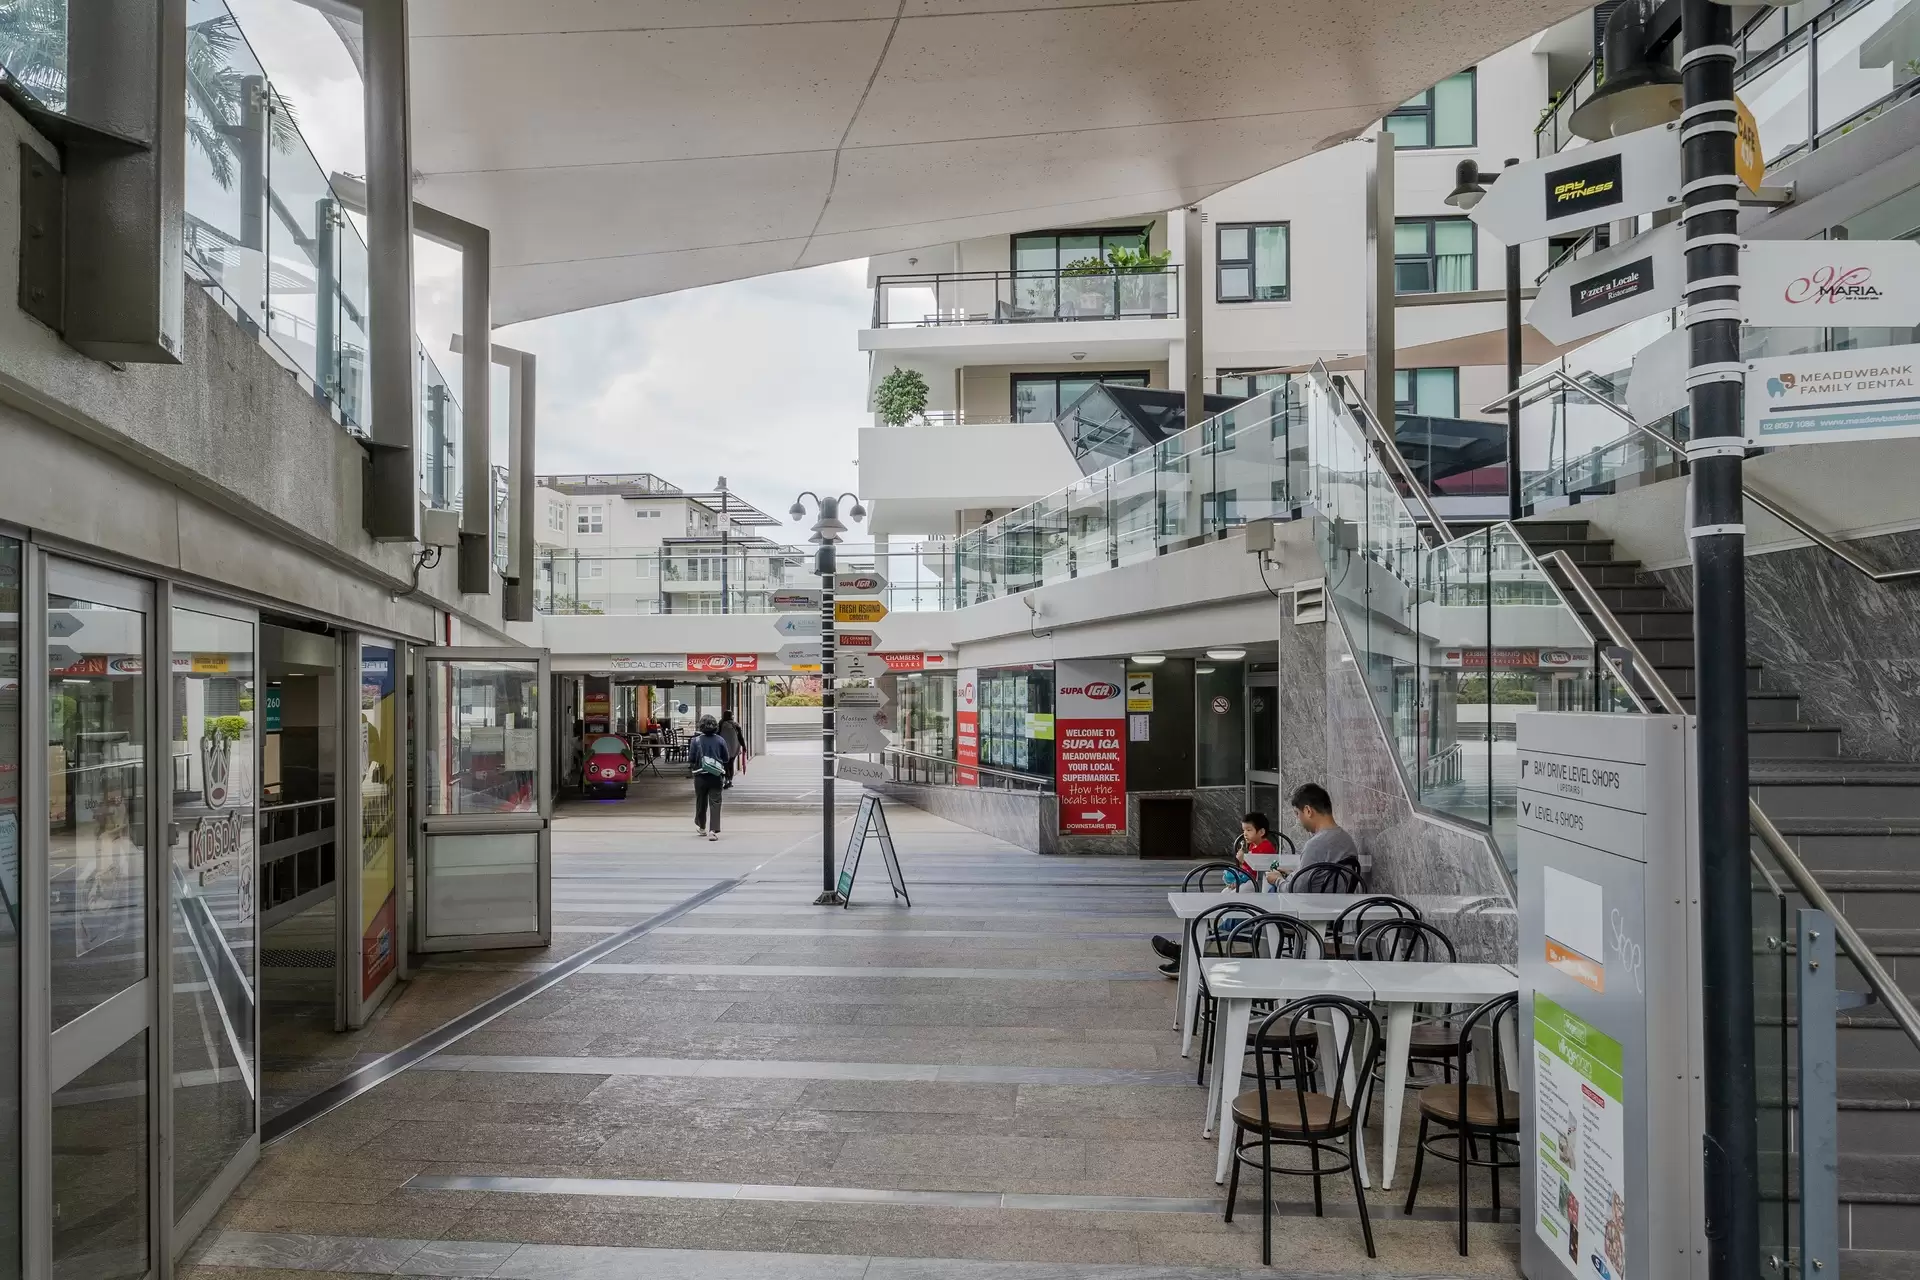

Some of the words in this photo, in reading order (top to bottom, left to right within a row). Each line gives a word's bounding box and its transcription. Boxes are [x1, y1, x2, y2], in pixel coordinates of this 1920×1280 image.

[1555, 180, 1585, 195] BAY
[1557, 181, 1613, 202] FITNESS
[1612, 272, 1640, 288] Locale
[1607, 284, 1638, 300] Ristorante
[1800, 365, 1912, 382] MEADOWBANK
[1800, 383, 1852, 395] FAMILY
[1857, 378, 1914, 390] DENTAL
[856, 579, 872, 588] IGA
[839, 604, 857, 613] FRESH
[611, 661, 646, 669] MEDICAL
[650, 661, 683, 669] CENTRE
[709, 656, 726, 666] IGA
[1060, 687, 1083, 695] SUPA
[1087, 685, 1110, 696] IGA
[1066, 729, 1103, 737] WELCOME
[1105, 729, 1115, 737] TO
[1062, 739, 1095, 749] SUPA
[1098, 739, 1120, 749] IGA
[1062, 752, 1120, 761] MEADOWBANK,
[1068, 763, 1088, 771] YOUR
[1090, 763, 1114, 771] LOCAL
[1062, 774, 1120, 782] SUPERMARKET.
[1534, 760, 1546, 776] BAY
[1547, 762, 1567, 780] DRIVE
[1568, 765, 1591, 784] LEVEL
[1592, 769, 1620, 790] SHOPS
[1069, 783, 1092, 795] How
[1095, 784, 1113, 794] the
[1061, 795, 1088, 805] locals
[1091, 795, 1107, 805] like
[1110, 795, 1122, 805] it.
[1535, 805, 1554, 823] LEVEL
[1554, 811, 1559, 825] 4
[1560, 811, 1584, 831] SHOPS
